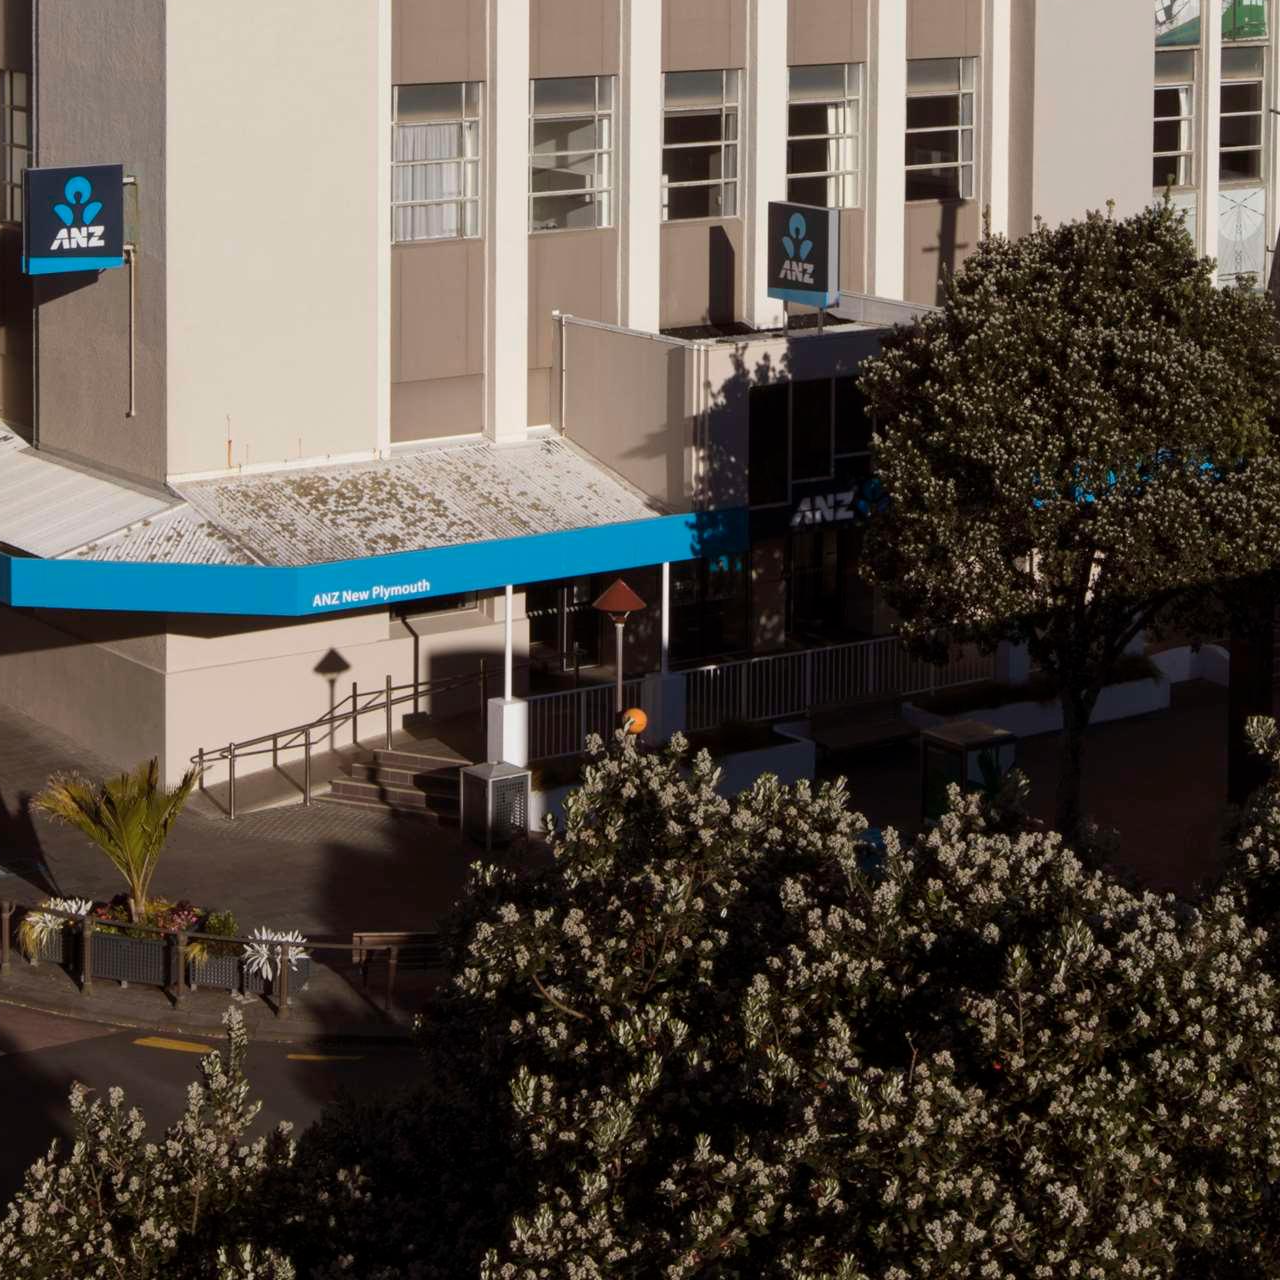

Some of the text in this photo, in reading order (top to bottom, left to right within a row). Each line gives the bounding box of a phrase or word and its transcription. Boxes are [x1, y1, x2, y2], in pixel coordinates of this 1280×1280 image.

[50, 225, 105, 251] ANZ
[779, 260, 815, 285] ANZ
[790, 491, 857, 526] ANZ
[312, 578, 431, 608] ANZ New Plymouth
